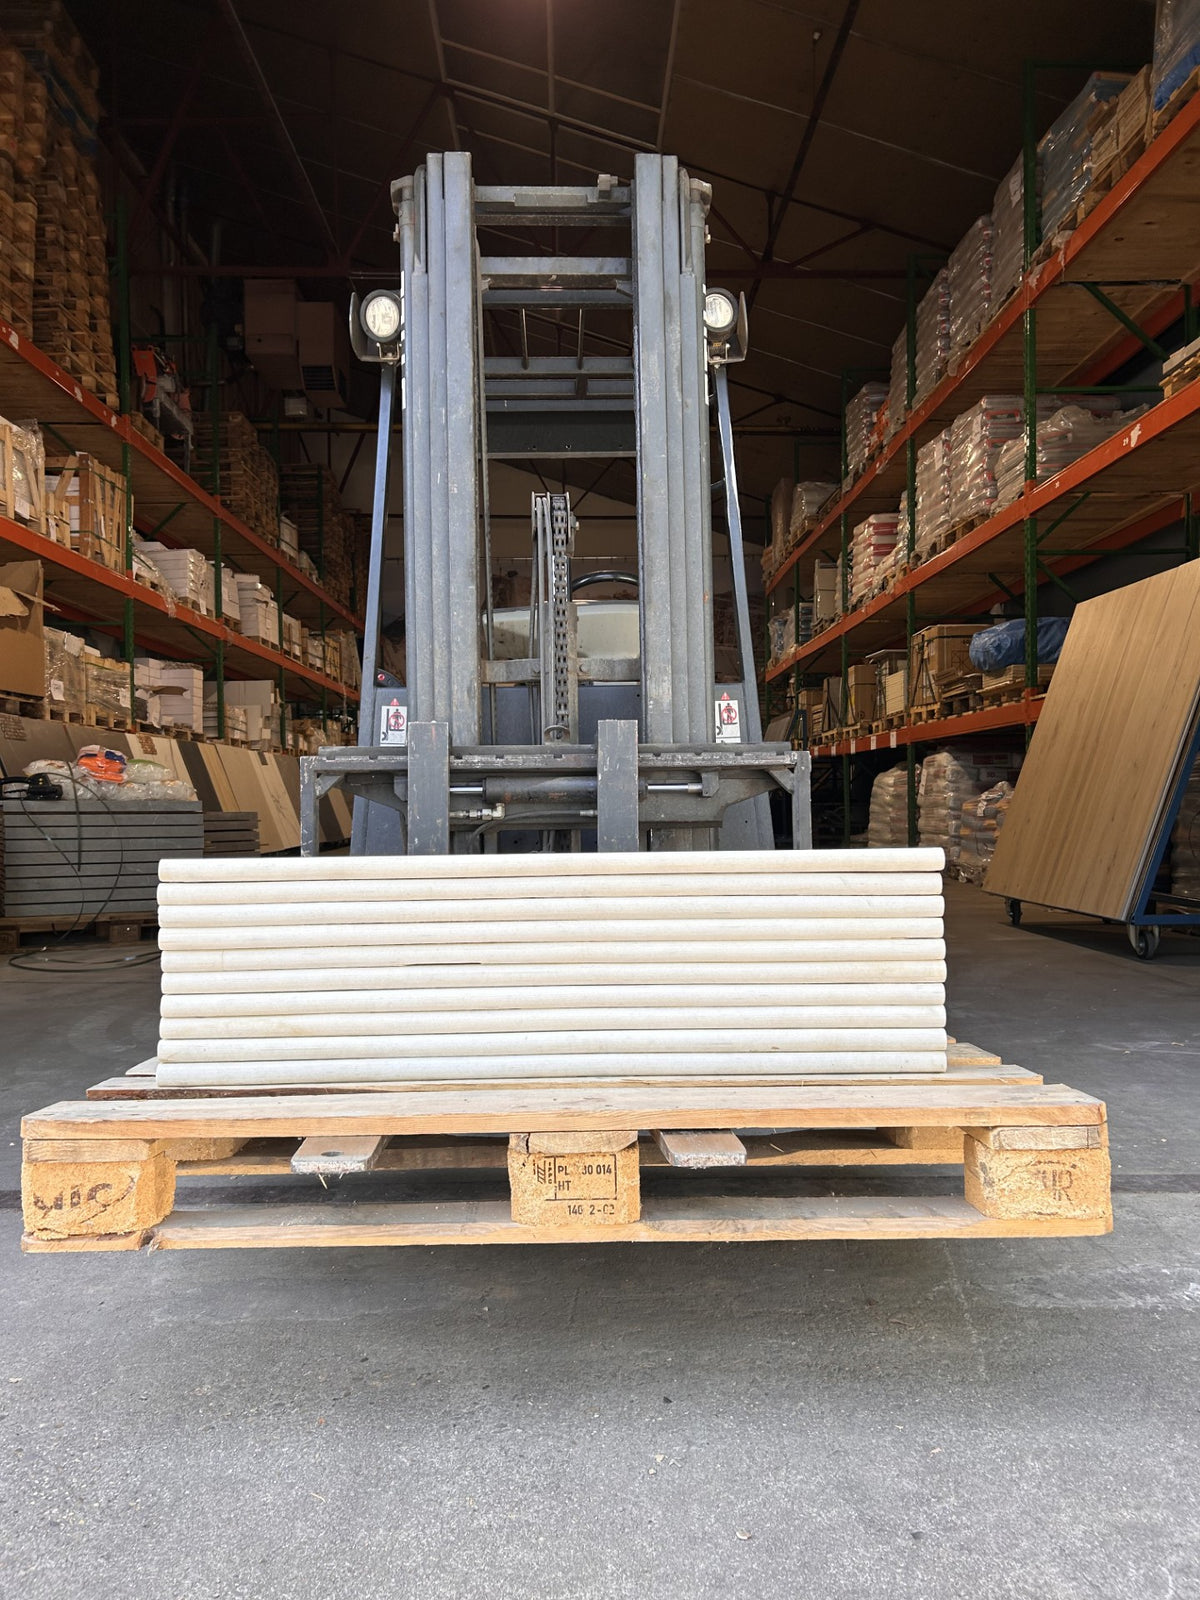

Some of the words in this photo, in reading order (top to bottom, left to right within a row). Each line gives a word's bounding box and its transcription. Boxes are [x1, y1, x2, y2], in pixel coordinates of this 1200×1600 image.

[557, 1165, 570, 1176] PL
[595, 1164, 612, 1175] 014
[557, 1180, 572, 1191] HT
[567, 1204, 584, 1215] 140
